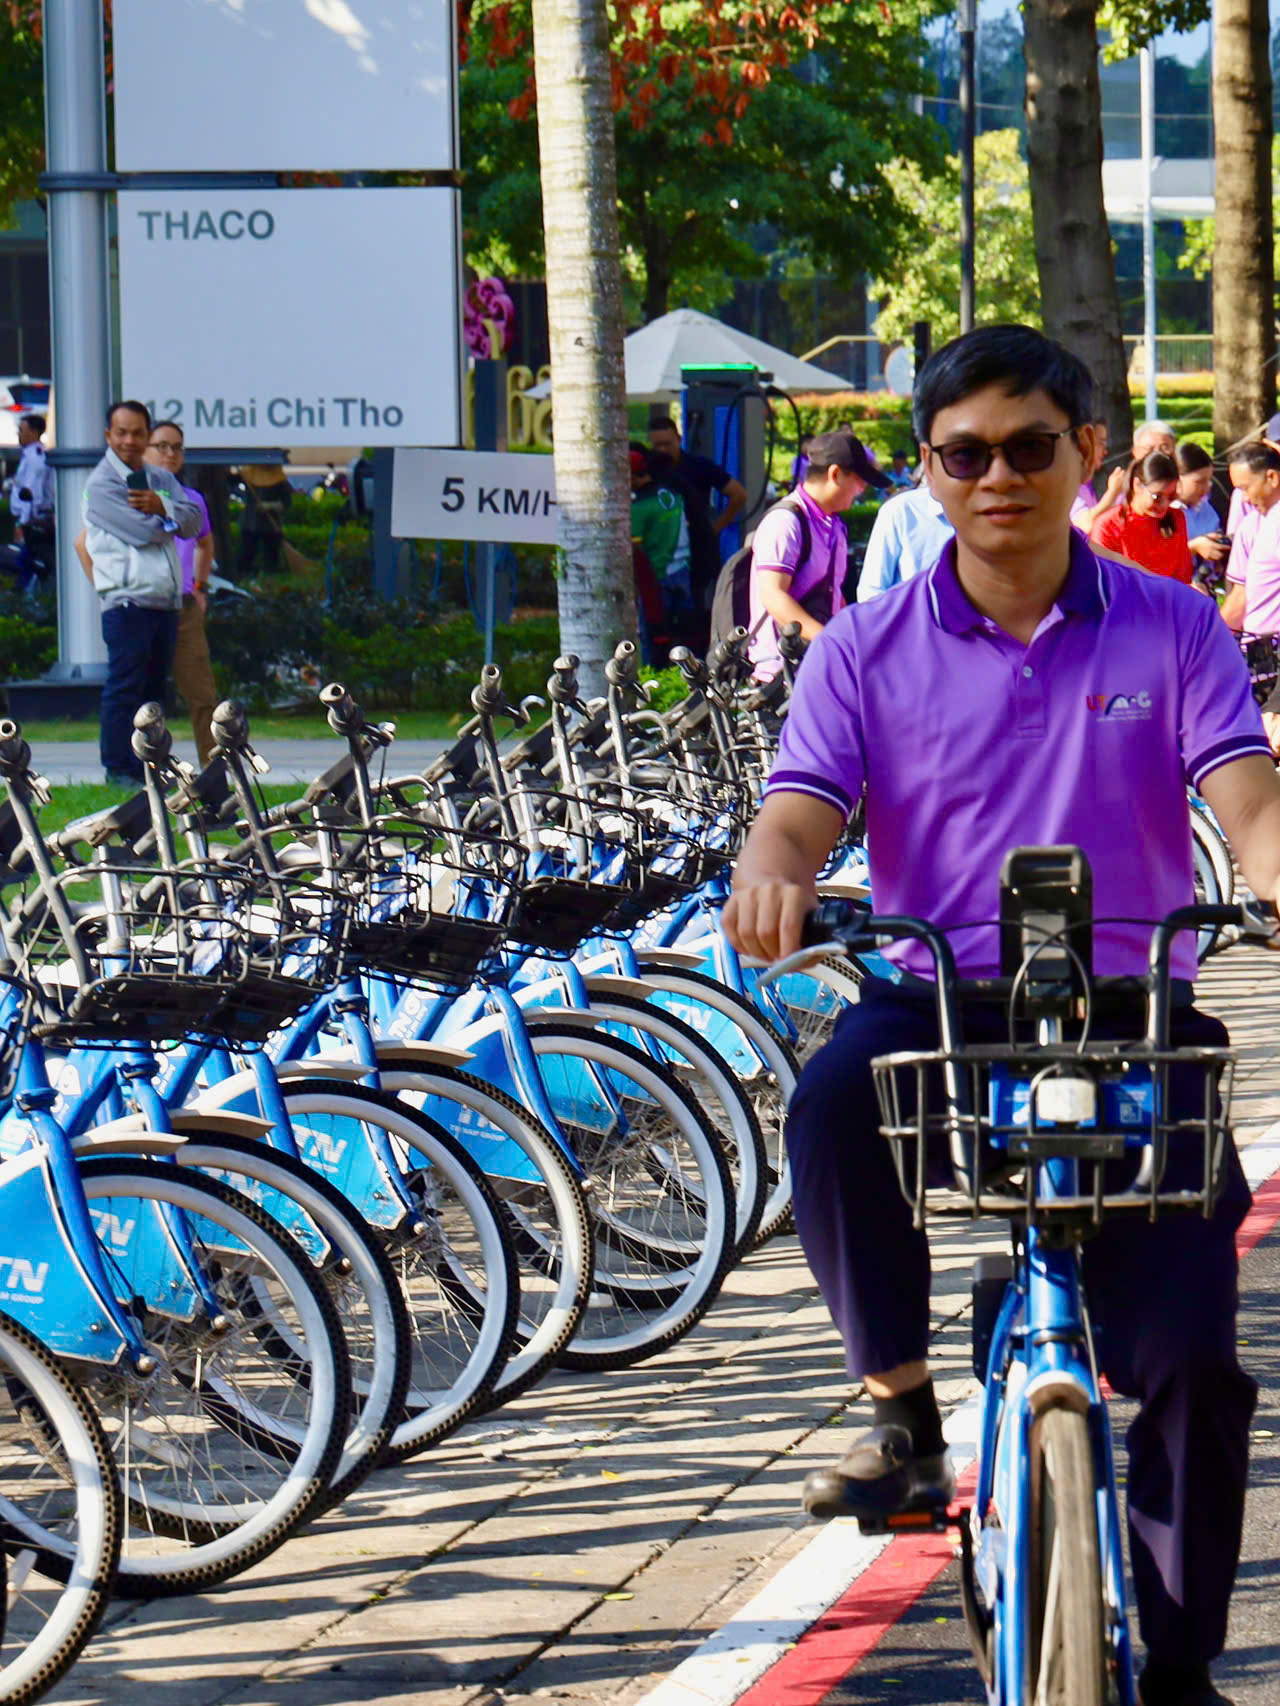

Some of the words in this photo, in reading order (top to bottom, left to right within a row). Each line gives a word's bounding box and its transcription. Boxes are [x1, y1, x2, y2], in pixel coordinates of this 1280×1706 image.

[137, 209, 275, 241] THACO
[195, 398, 257, 428] Mai
[267, 398, 325, 428] Chi
[333, 398, 404, 428] Tho
[441, 477, 465, 512] 5
